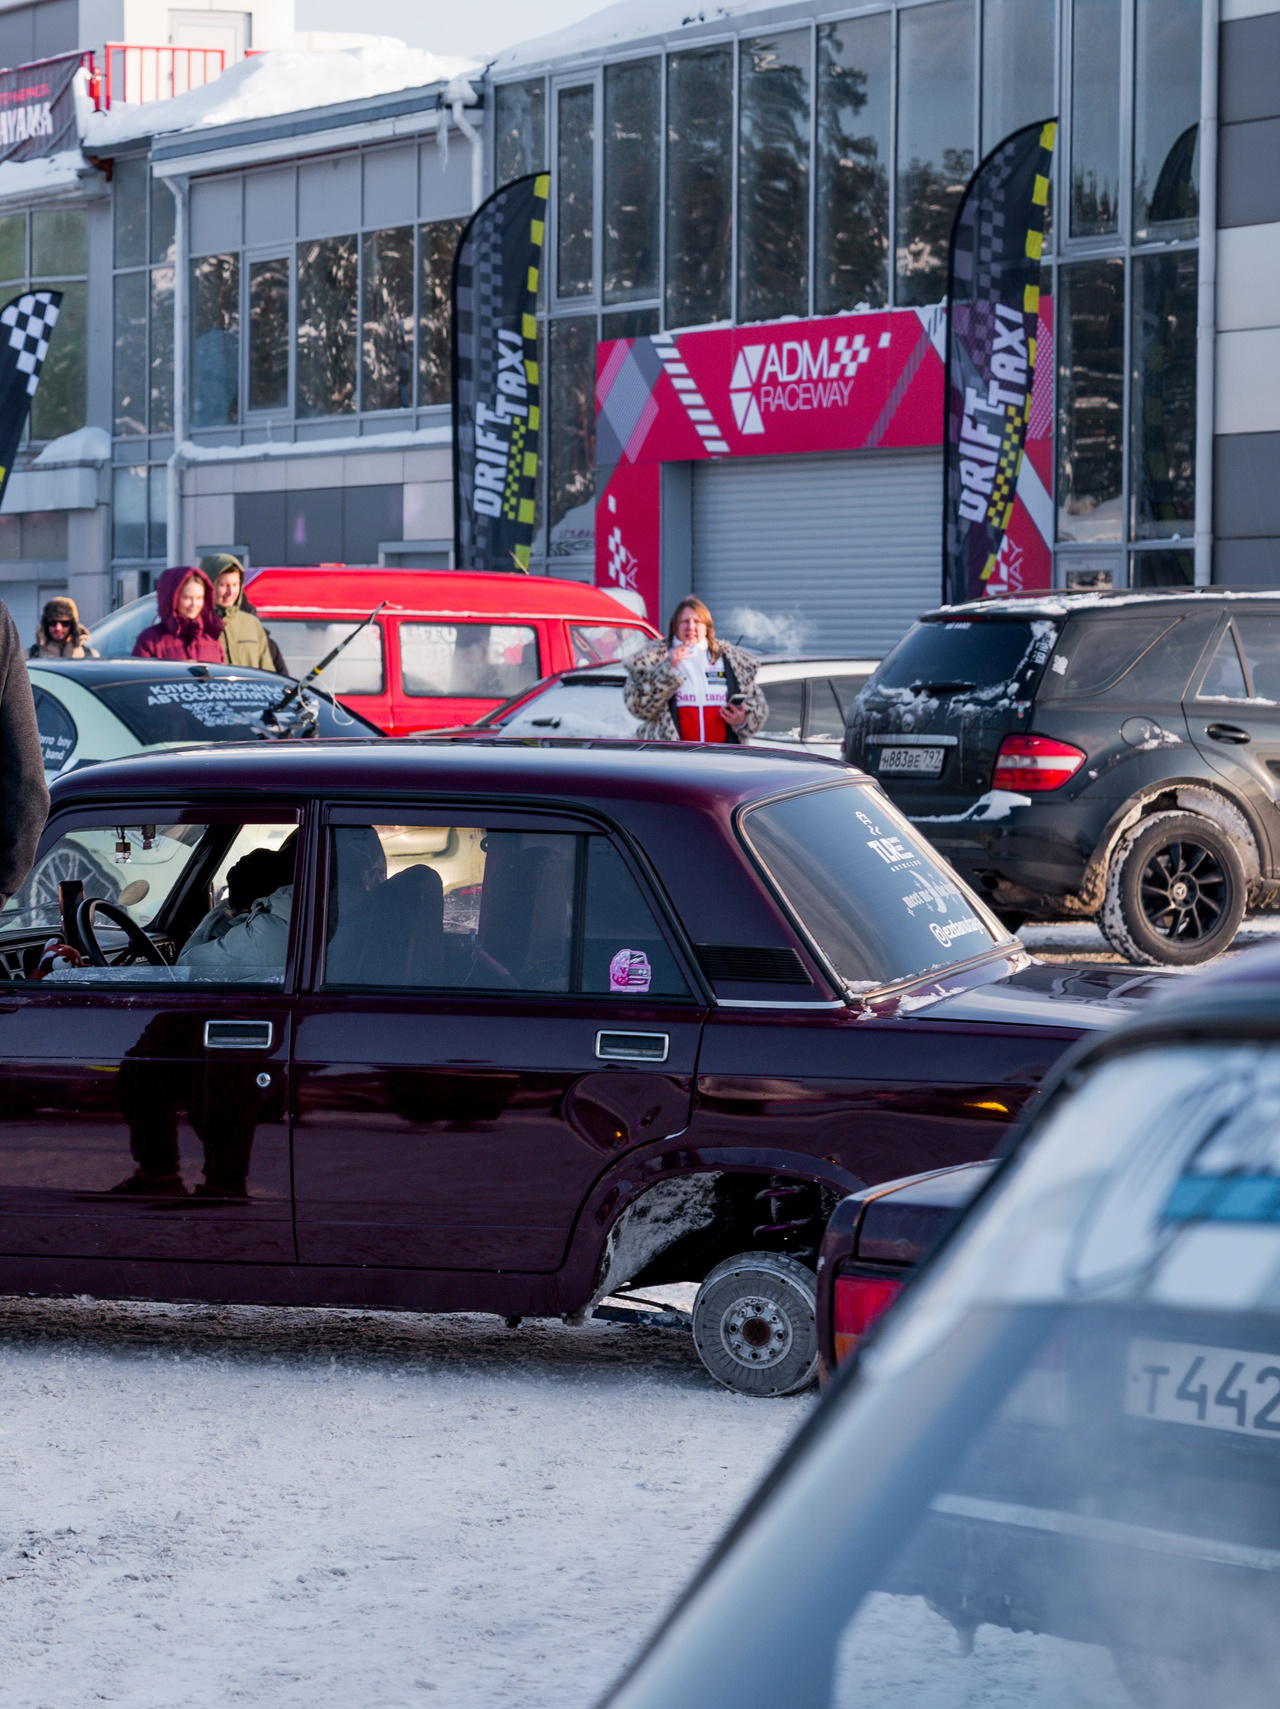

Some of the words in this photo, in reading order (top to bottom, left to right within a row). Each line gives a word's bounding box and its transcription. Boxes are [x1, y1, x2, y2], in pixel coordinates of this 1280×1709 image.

[761, 337, 830, 384] ADM
[760, 379, 854, 413] RACEWAY
[473, 401, 510, 519] DRIFT
[495, 328, 529, 425] TAXI
[958, 387, 1003, 523] DRIFT
[987, 303, 1028, 416] TAXI
[148, 691, 287, 706] АВТОСИМУЛЯТО
[150, 682, 199, 695] КЛУБ
[200, 682, 284, 694] ГОНОЧНЫ
[675, 691, 697, 702] San
[923, 750, 941, 763] 797
